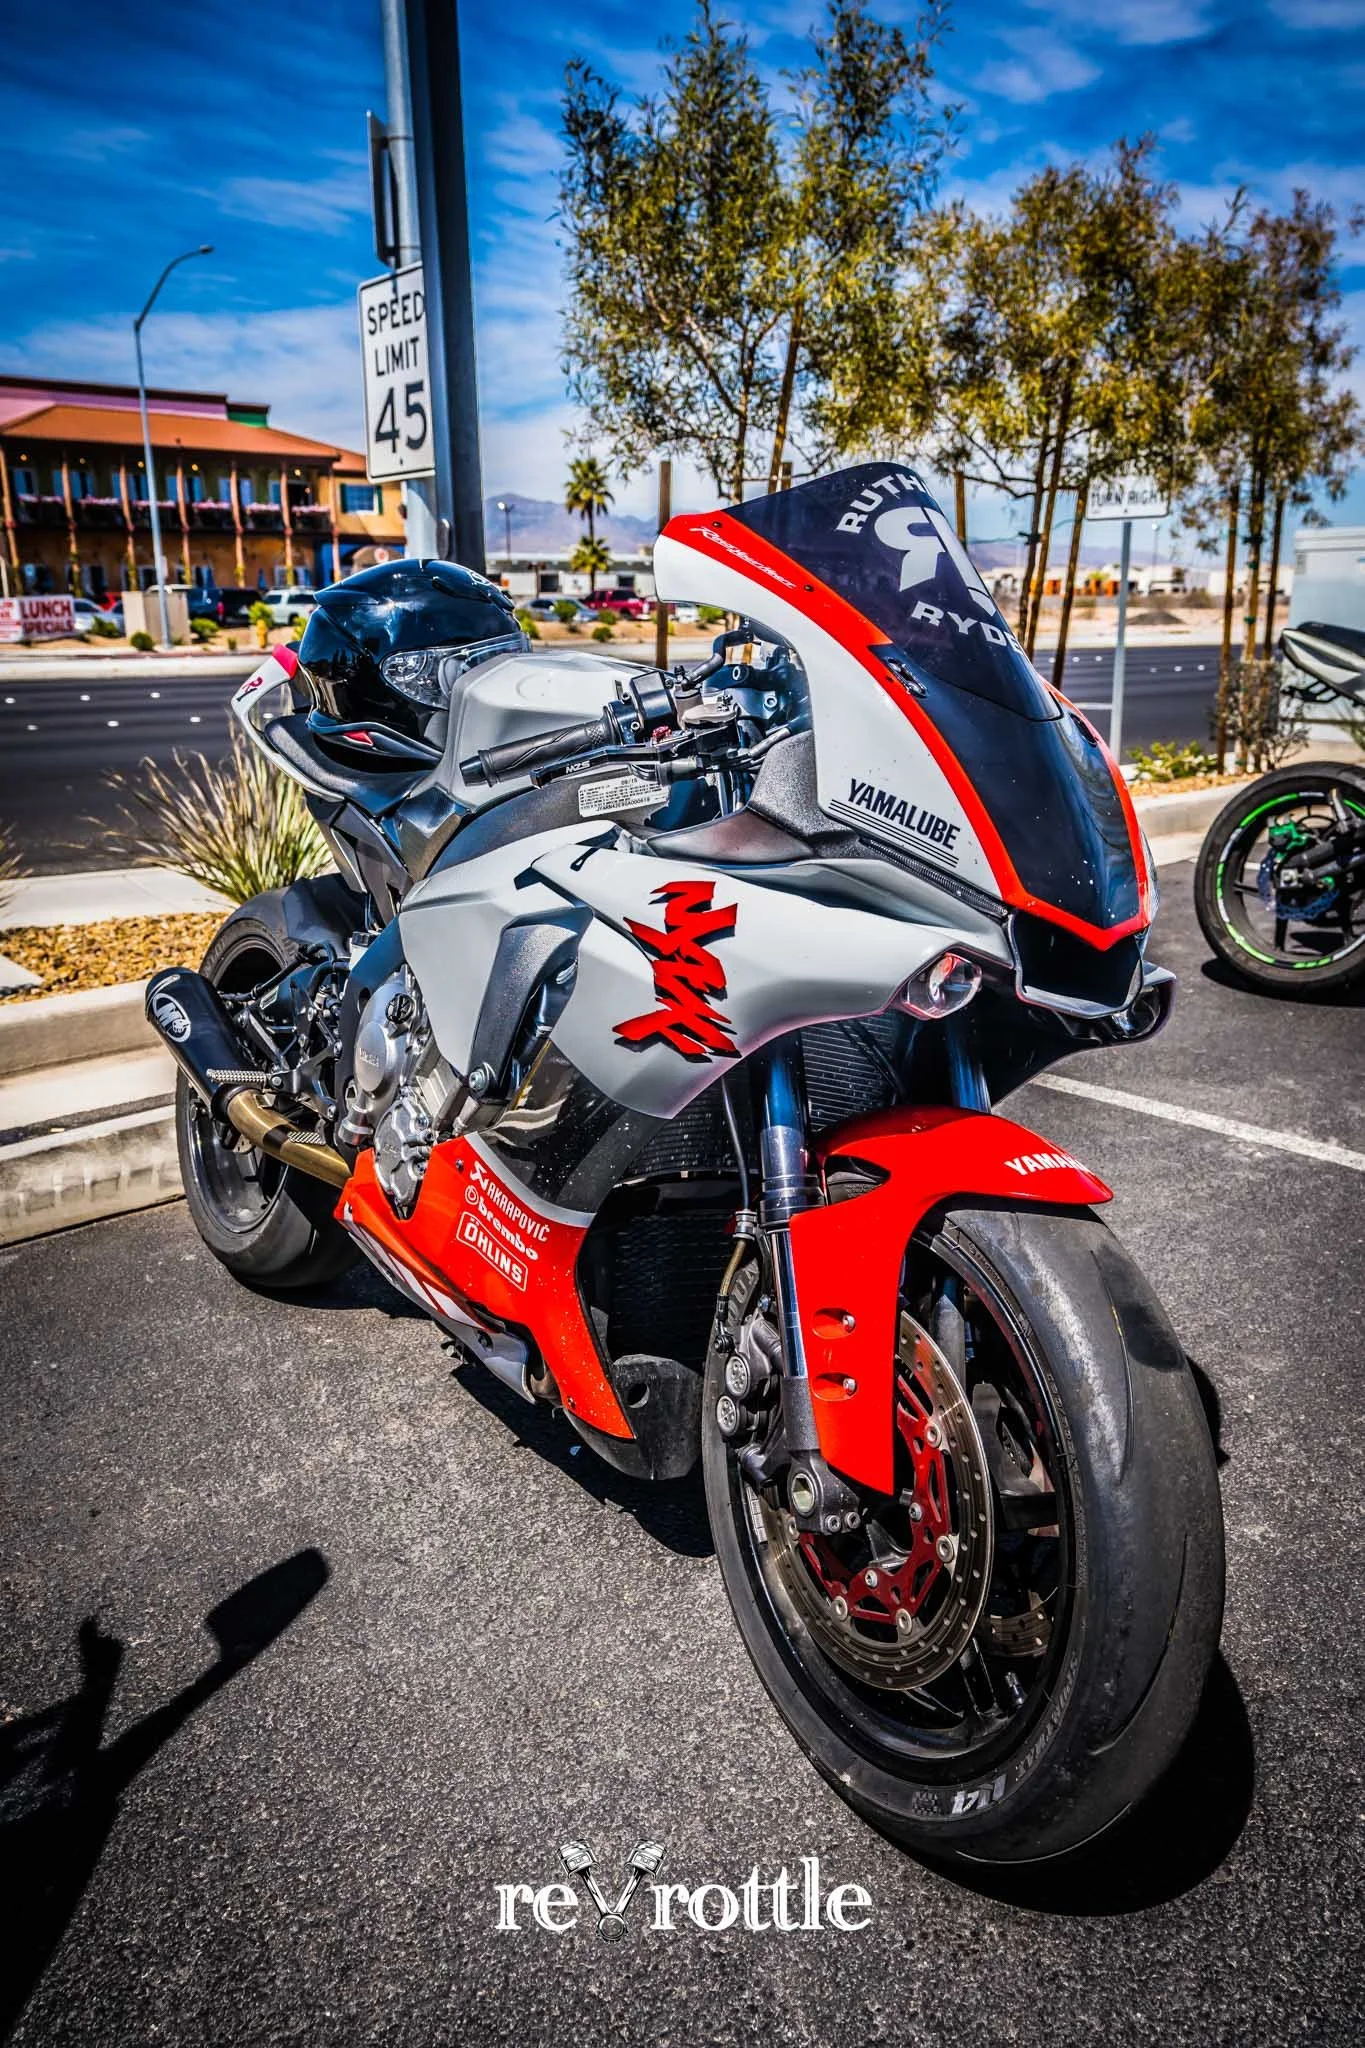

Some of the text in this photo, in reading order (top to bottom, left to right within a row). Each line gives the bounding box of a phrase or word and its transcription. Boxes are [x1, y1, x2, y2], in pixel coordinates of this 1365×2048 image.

[367, 290, 425, 336] SPEED
[375, 336, 420, 376] LIMIT
[375, 380, 428, 453] 45
[836, 473, 933, 534] RUTH
[20, 600, 72, 618] LUNCH
[847, 778, 960, 850] YAMALUBE
[464, 1216, 523, 1284] ÖHLINS
[478, 1196, 539, 1261] brembo
